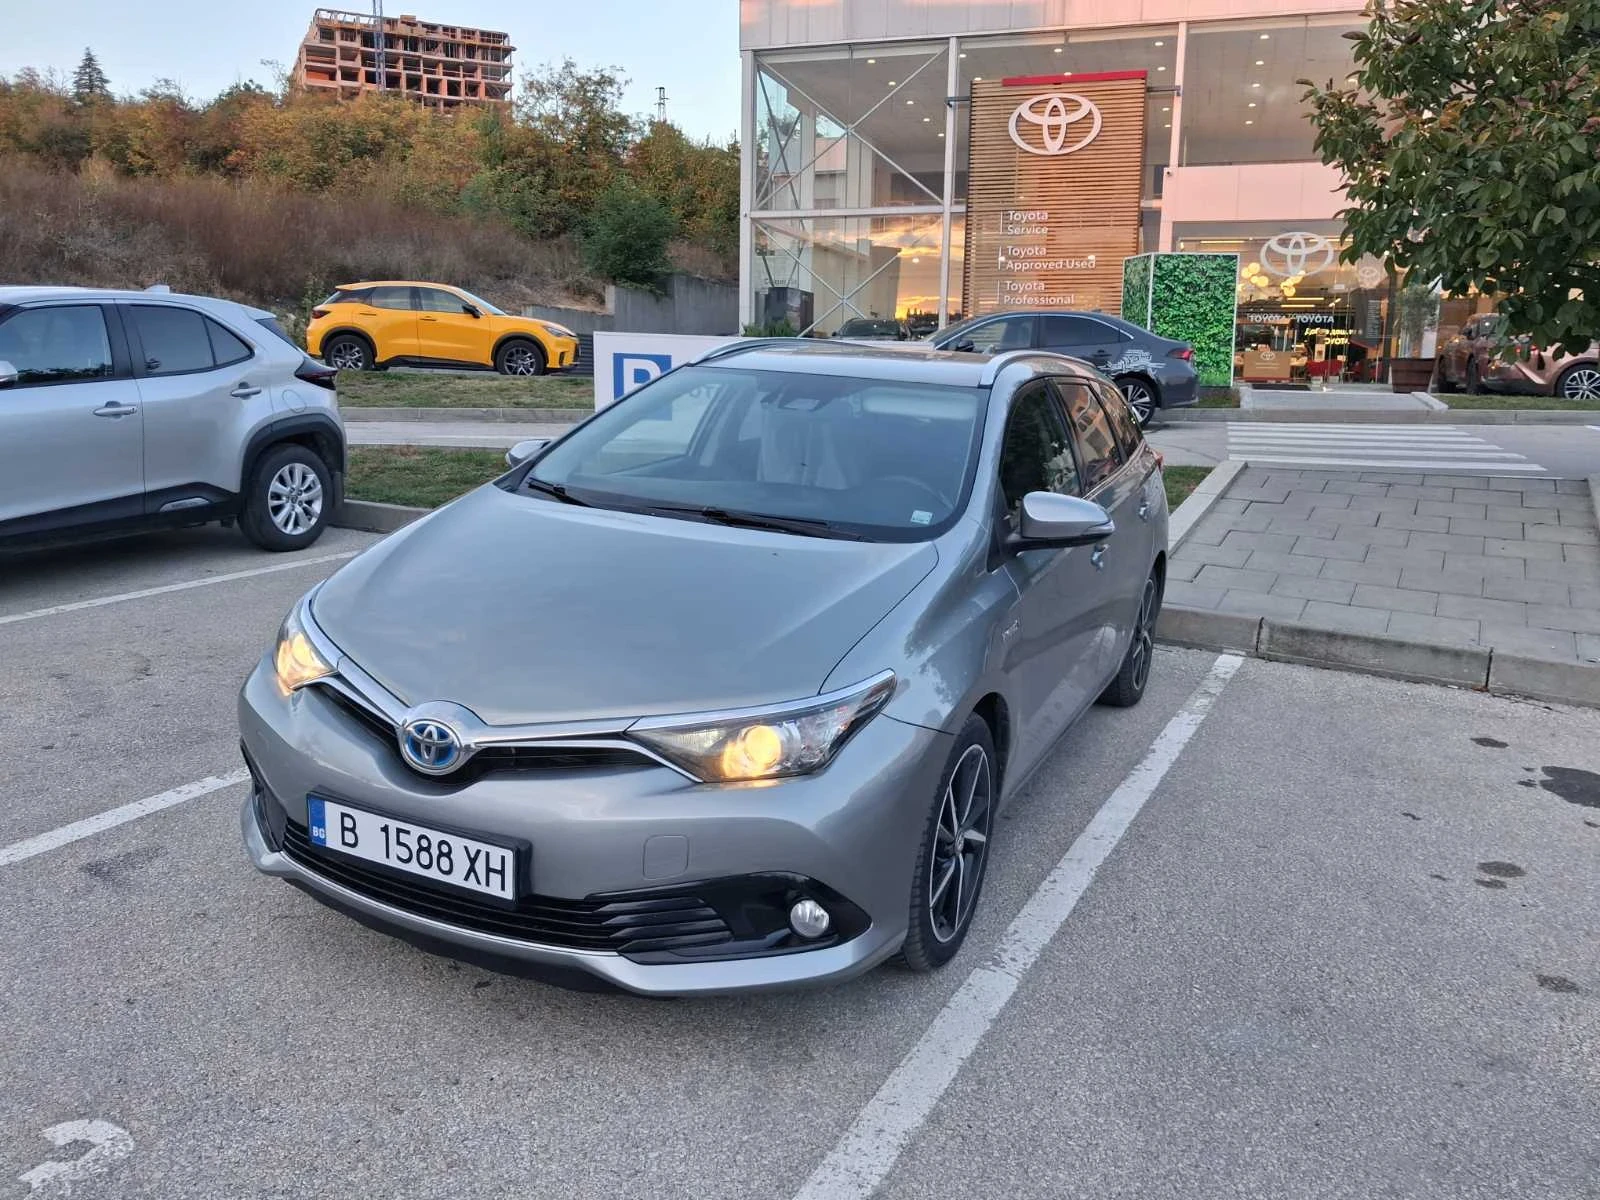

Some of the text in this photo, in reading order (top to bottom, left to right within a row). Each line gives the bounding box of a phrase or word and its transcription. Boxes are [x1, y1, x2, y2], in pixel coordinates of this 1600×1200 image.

[1008, 211, 1049, 223] Toyota
[1007, 225, 1049, 235] Service
[1006, 246, 1047, 257] Toyota
[1006, 259, 1096, 272] Approved Used
[1005, 281, 1045, 293] Toyota
[1003, 295, 1075, 305] Professional
[1296, 315, 1335, 323] TOYOTA
[312, 826, 326, 838] BG
[340, 811, 506, 892] B 1588 XH
